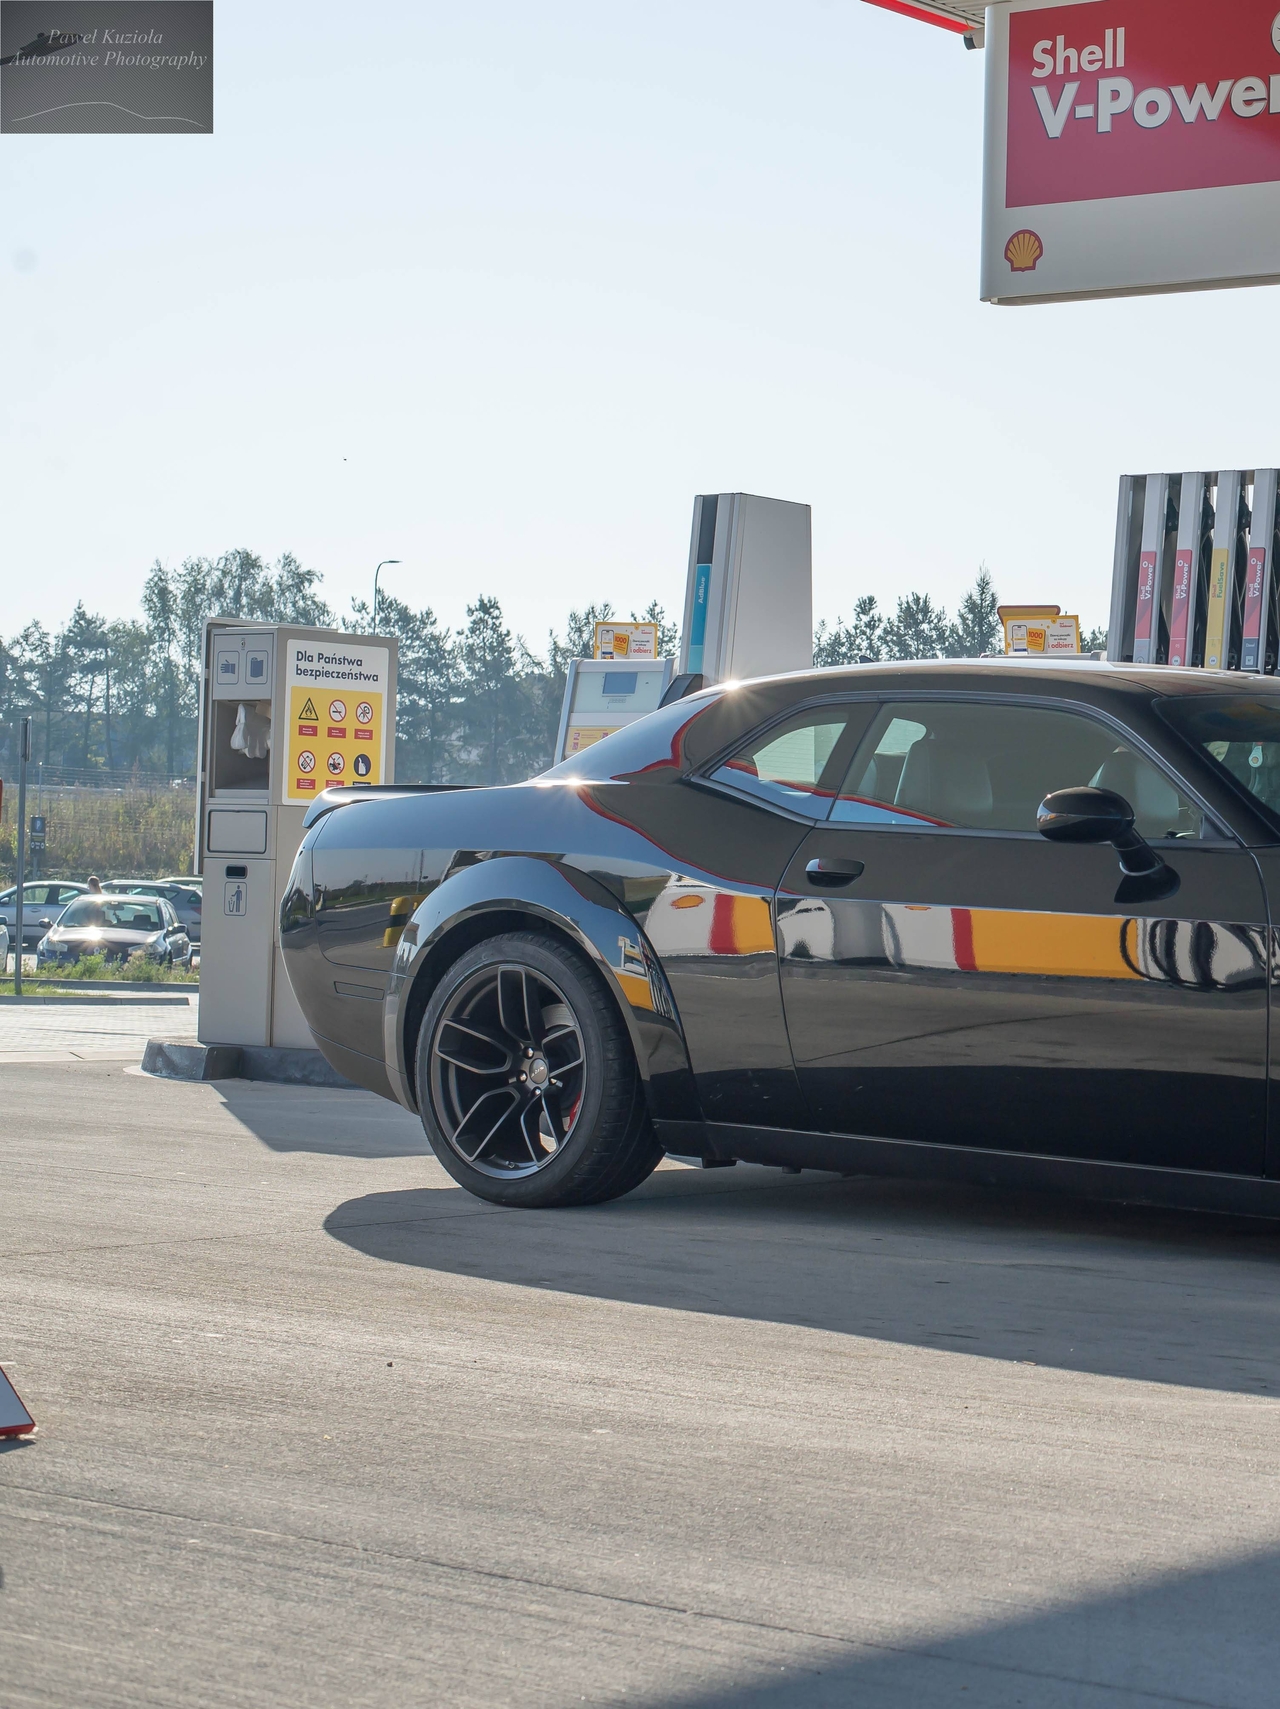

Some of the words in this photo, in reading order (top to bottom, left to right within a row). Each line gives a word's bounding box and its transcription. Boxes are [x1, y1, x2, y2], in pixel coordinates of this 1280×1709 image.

[1032, 26, 1126, 79] Shell
[698, 576, 706, 604] AdBlue
[1144, 563, 1154, 599] V-Power
[1180, 562, 1189, 599] V-Power
[1253, 560, 1262, 597] V-Power
[1028, 630, 1043, 640] 1000
[1051, 641, 1074, 649] odbierz
[296, 650, 314, 663] Dla
[317, 651, 363, 667] Państwa
[295, 664, 379, 683] bezpieczeństwa
